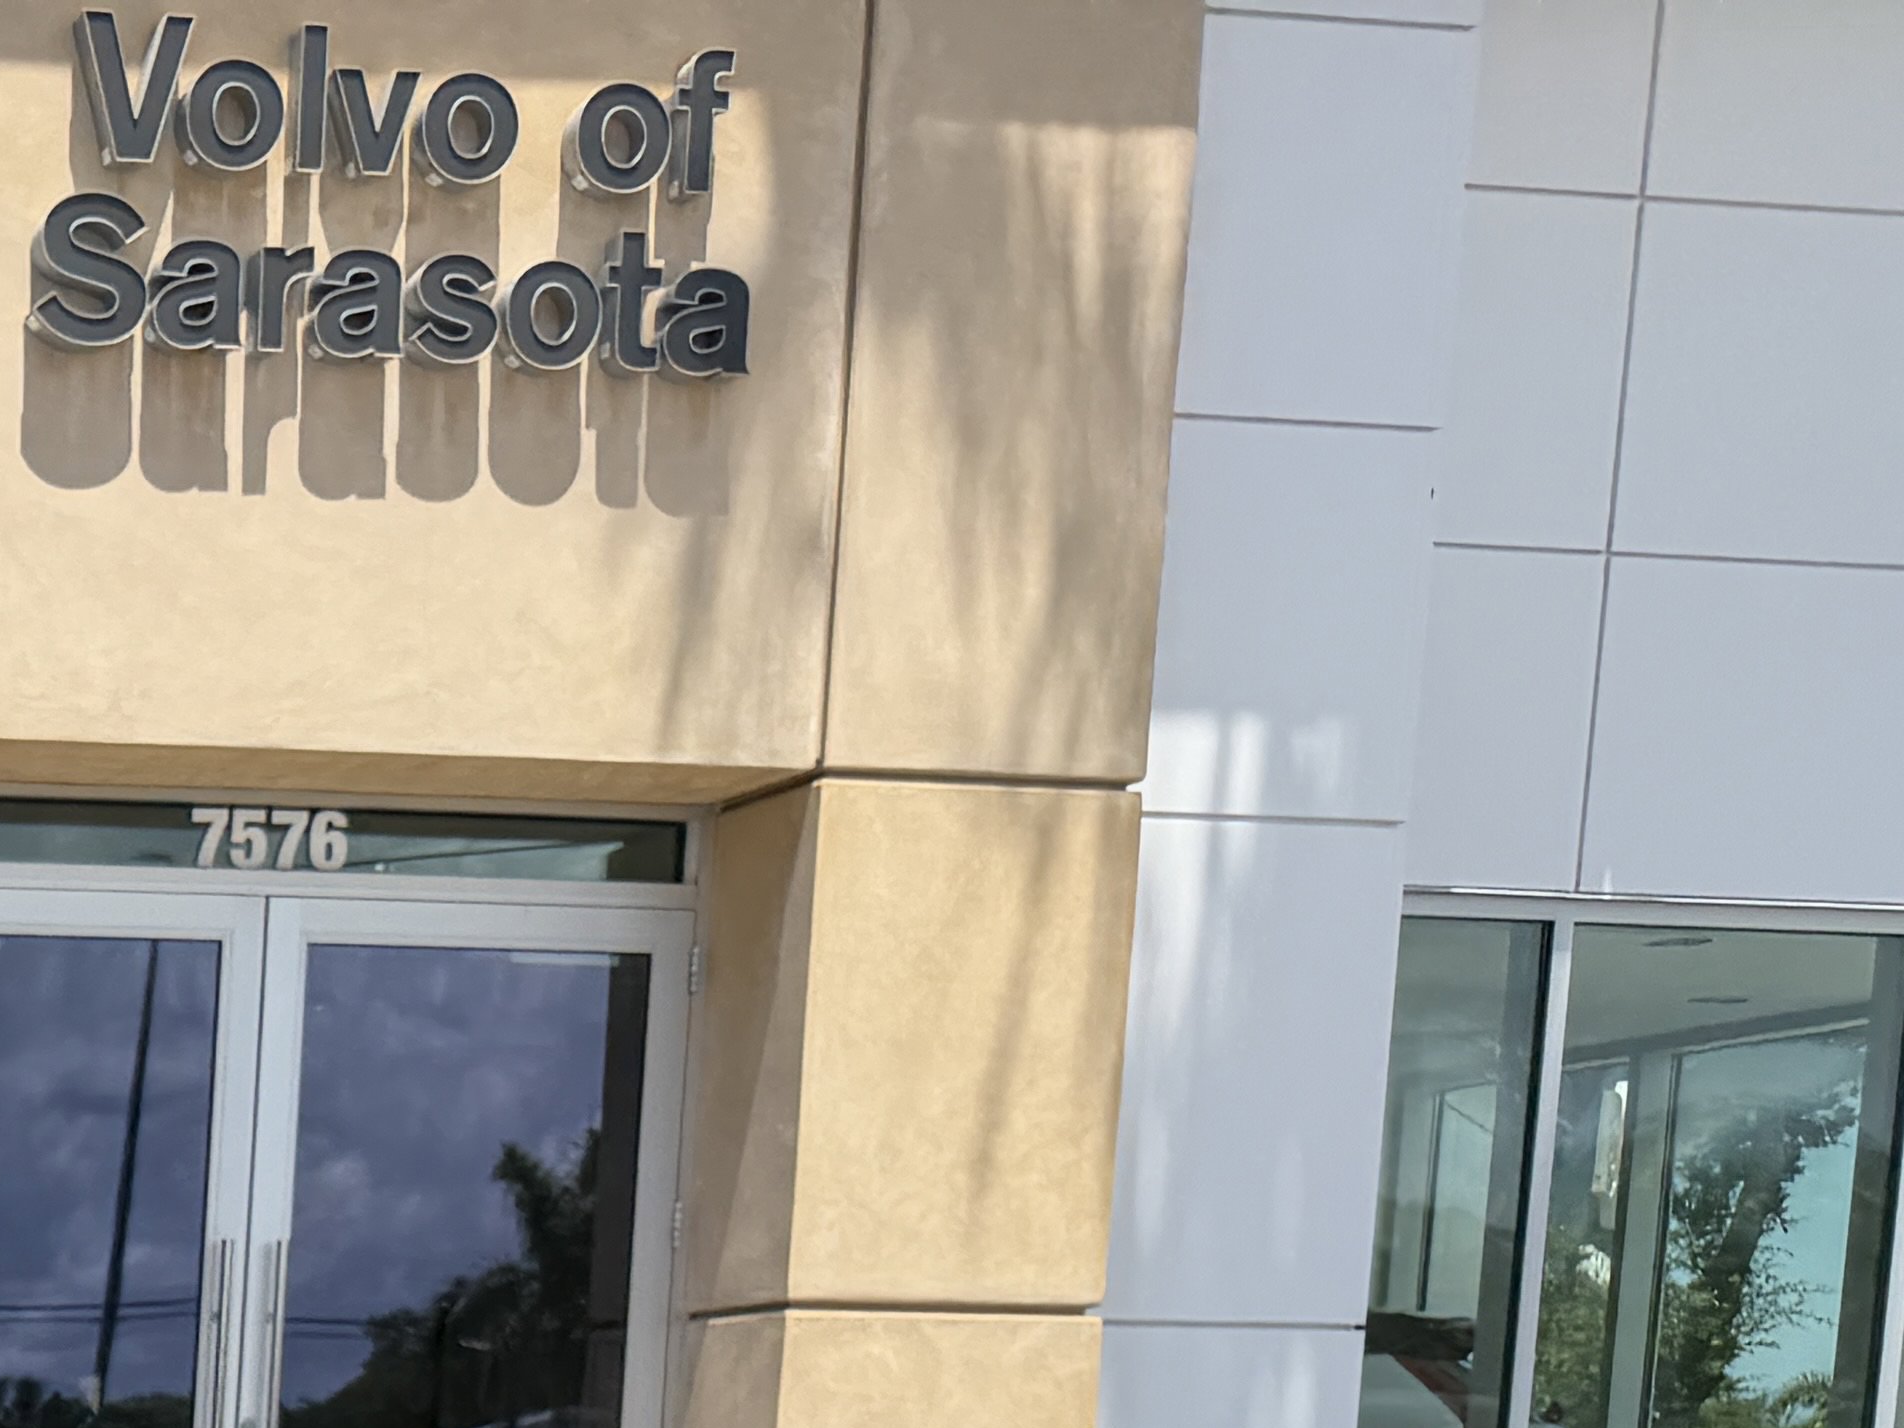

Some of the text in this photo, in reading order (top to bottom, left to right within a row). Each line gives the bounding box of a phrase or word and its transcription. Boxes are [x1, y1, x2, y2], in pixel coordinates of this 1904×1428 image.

[74, 8, 737, 195] Volvo of
[28, 191, 751, 378] Sarasota
[191, 807, 350, 871] 7576
